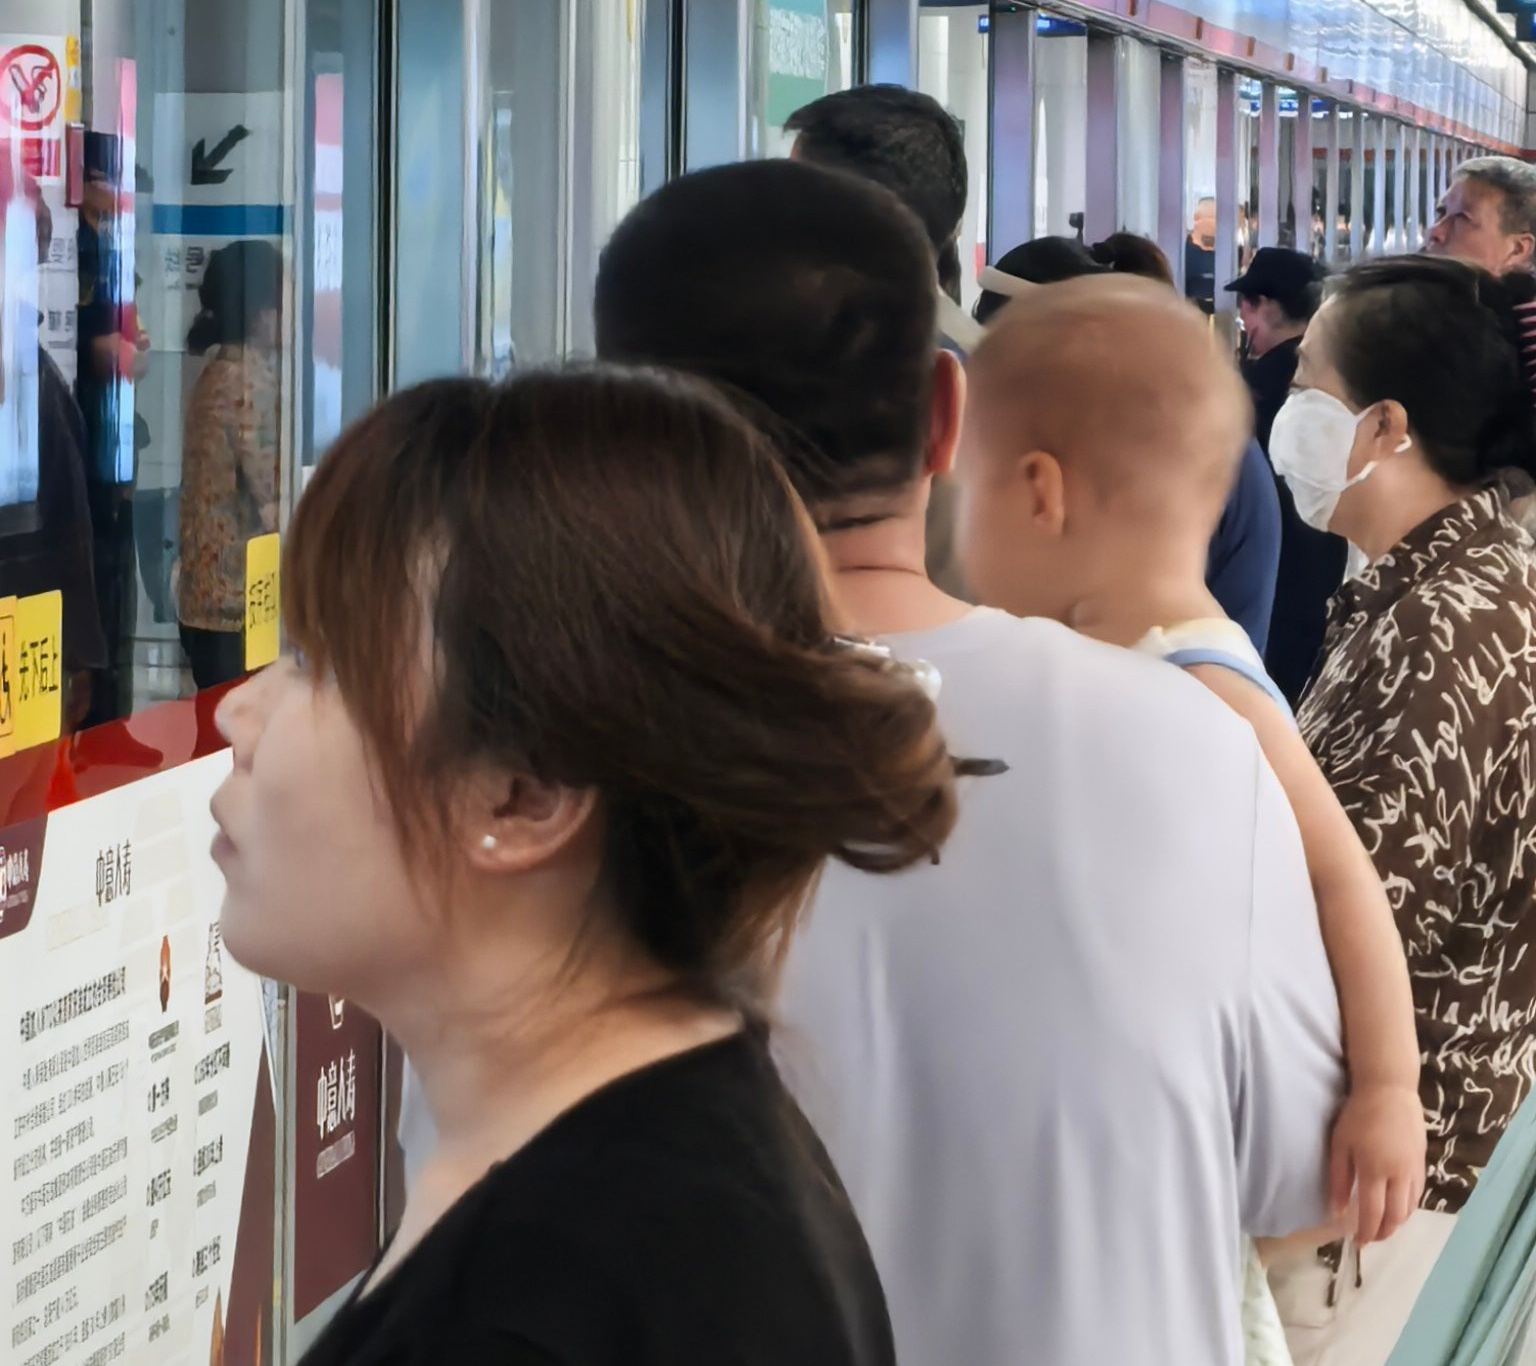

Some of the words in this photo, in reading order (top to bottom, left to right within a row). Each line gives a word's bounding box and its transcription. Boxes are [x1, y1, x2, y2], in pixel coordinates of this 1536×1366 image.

[19, 634, 59, 702] 先下后上
[96, 838, 132, 907] 中意人寿
[316, 1048, 356, 1140] 中意人寿
